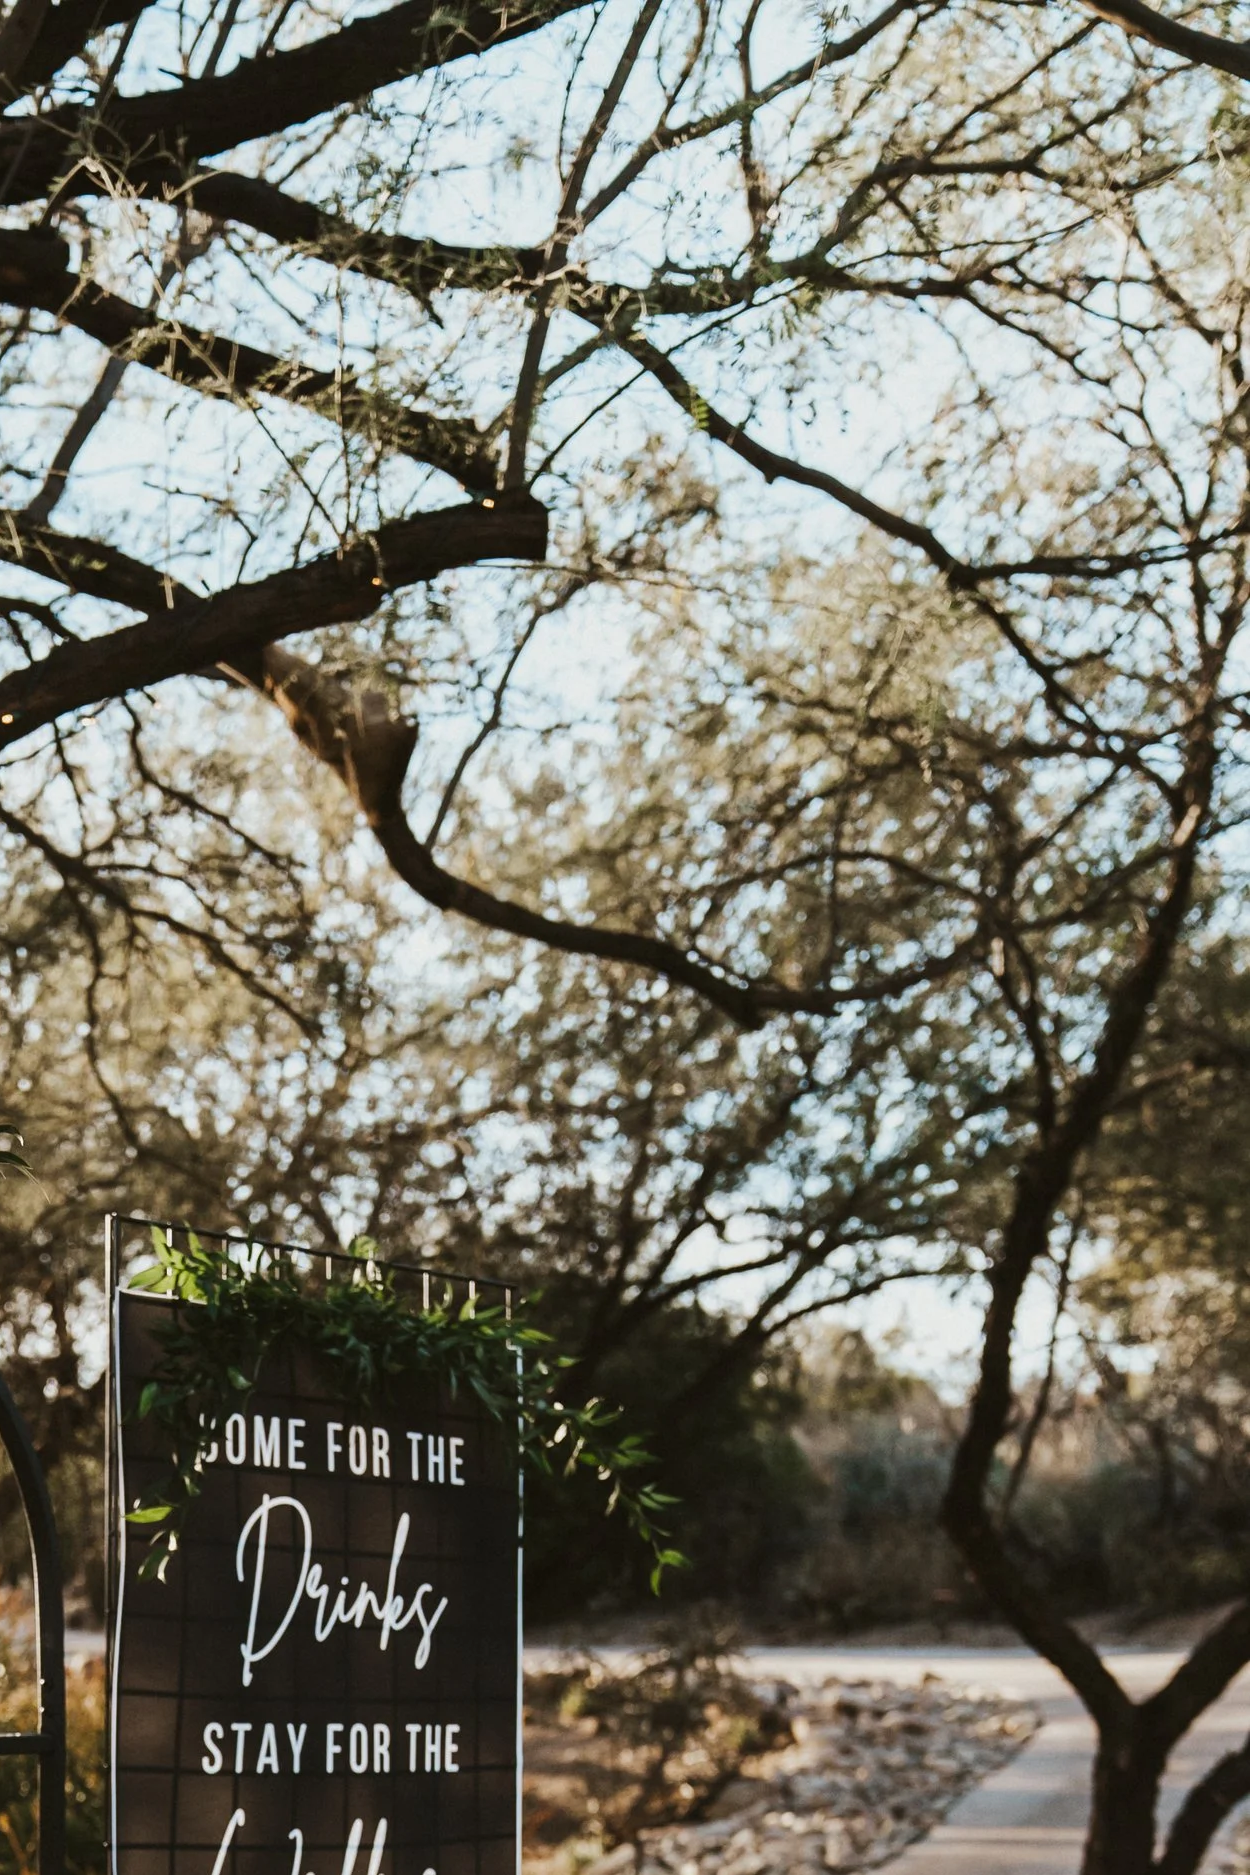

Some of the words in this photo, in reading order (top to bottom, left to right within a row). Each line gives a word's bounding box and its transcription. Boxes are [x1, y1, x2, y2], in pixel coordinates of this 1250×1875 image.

[327, 1422, 391, 1478] FOR
[406, 1431, 465, 1486] THE
[236, 1493, 448, 1687] Drinks
[201, 1722, 308, 1775] STAY
[326, 1722, 391, 1774] FOR
[405, 1723, 461, 1773] THE
